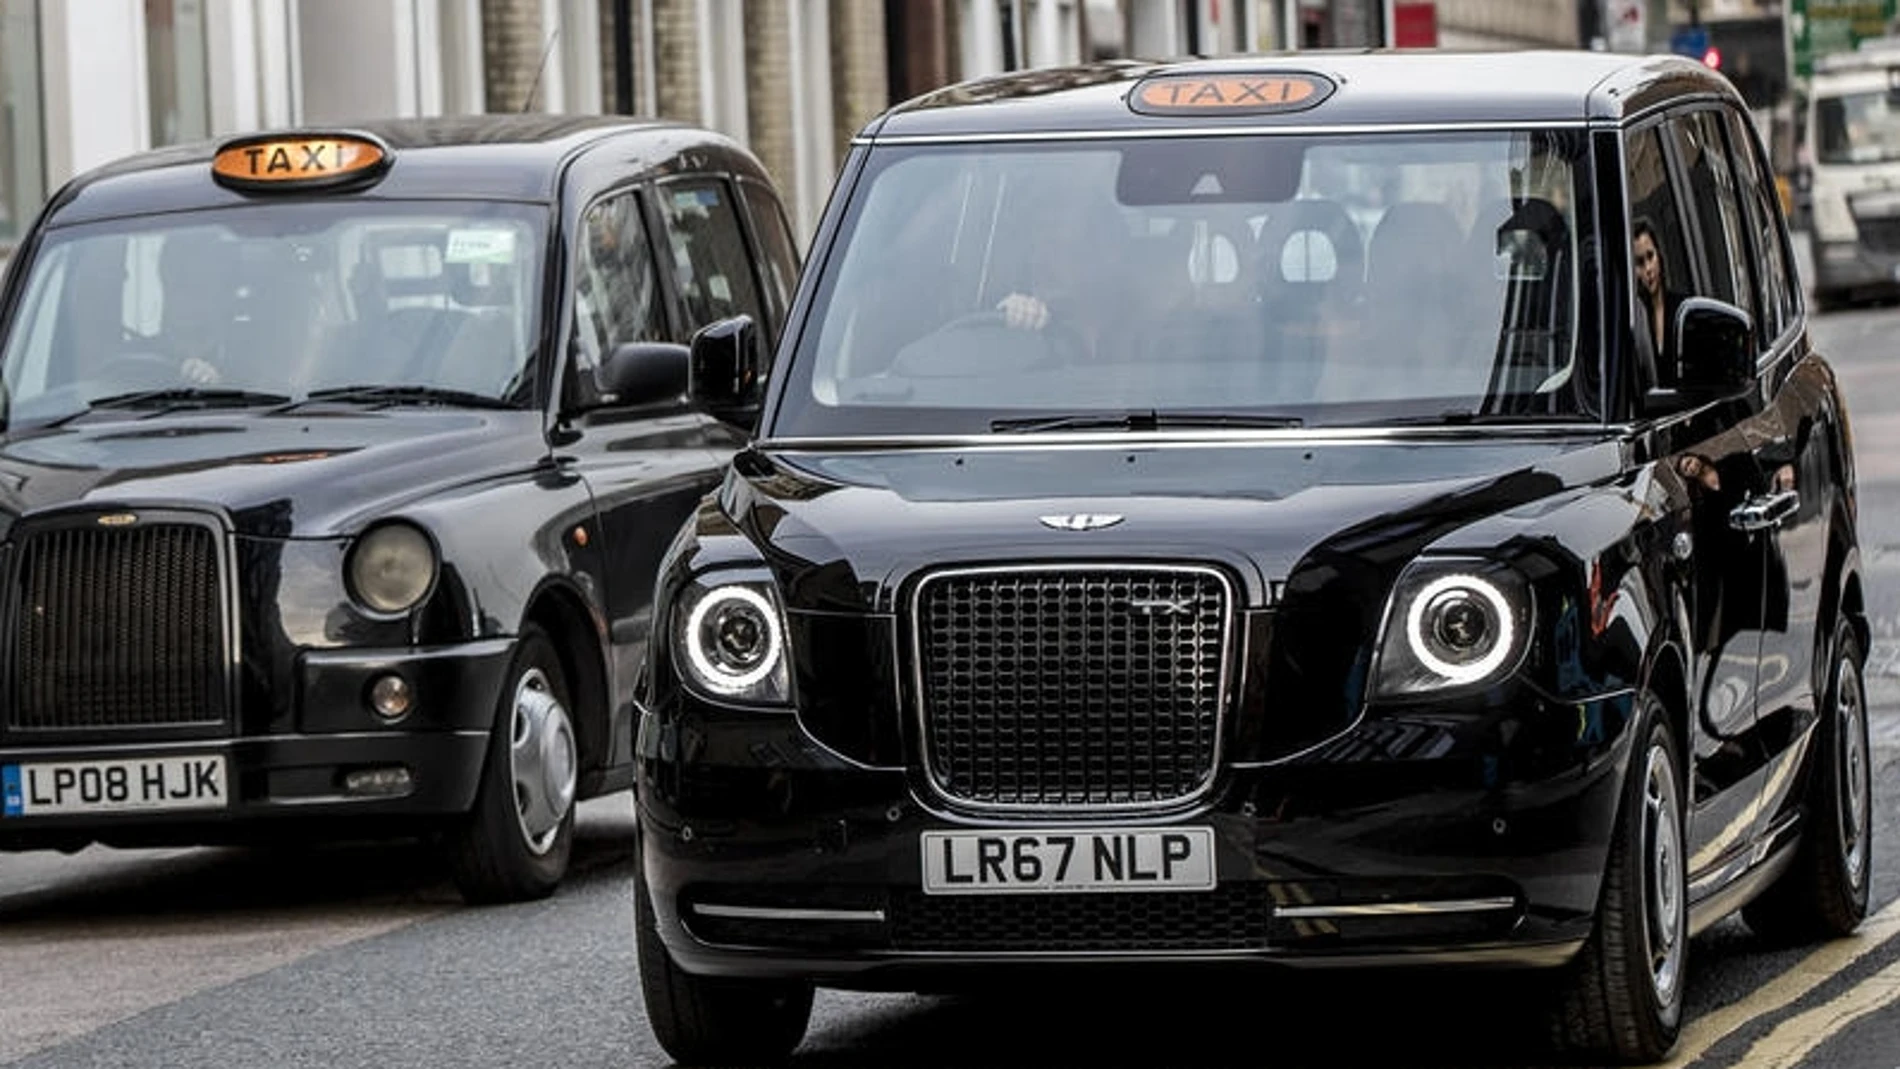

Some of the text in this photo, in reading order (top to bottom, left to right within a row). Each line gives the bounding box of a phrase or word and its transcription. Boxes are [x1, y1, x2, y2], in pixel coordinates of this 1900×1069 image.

[1162, 82, 1291, 104] TAXI
[244, 144, 342, 175] TAXI
[1132, 600, 1191, 615] TX
[28, 761, 219, 804] LP08 HJK
[943, 834, 1191, 883] LR67 NLP
